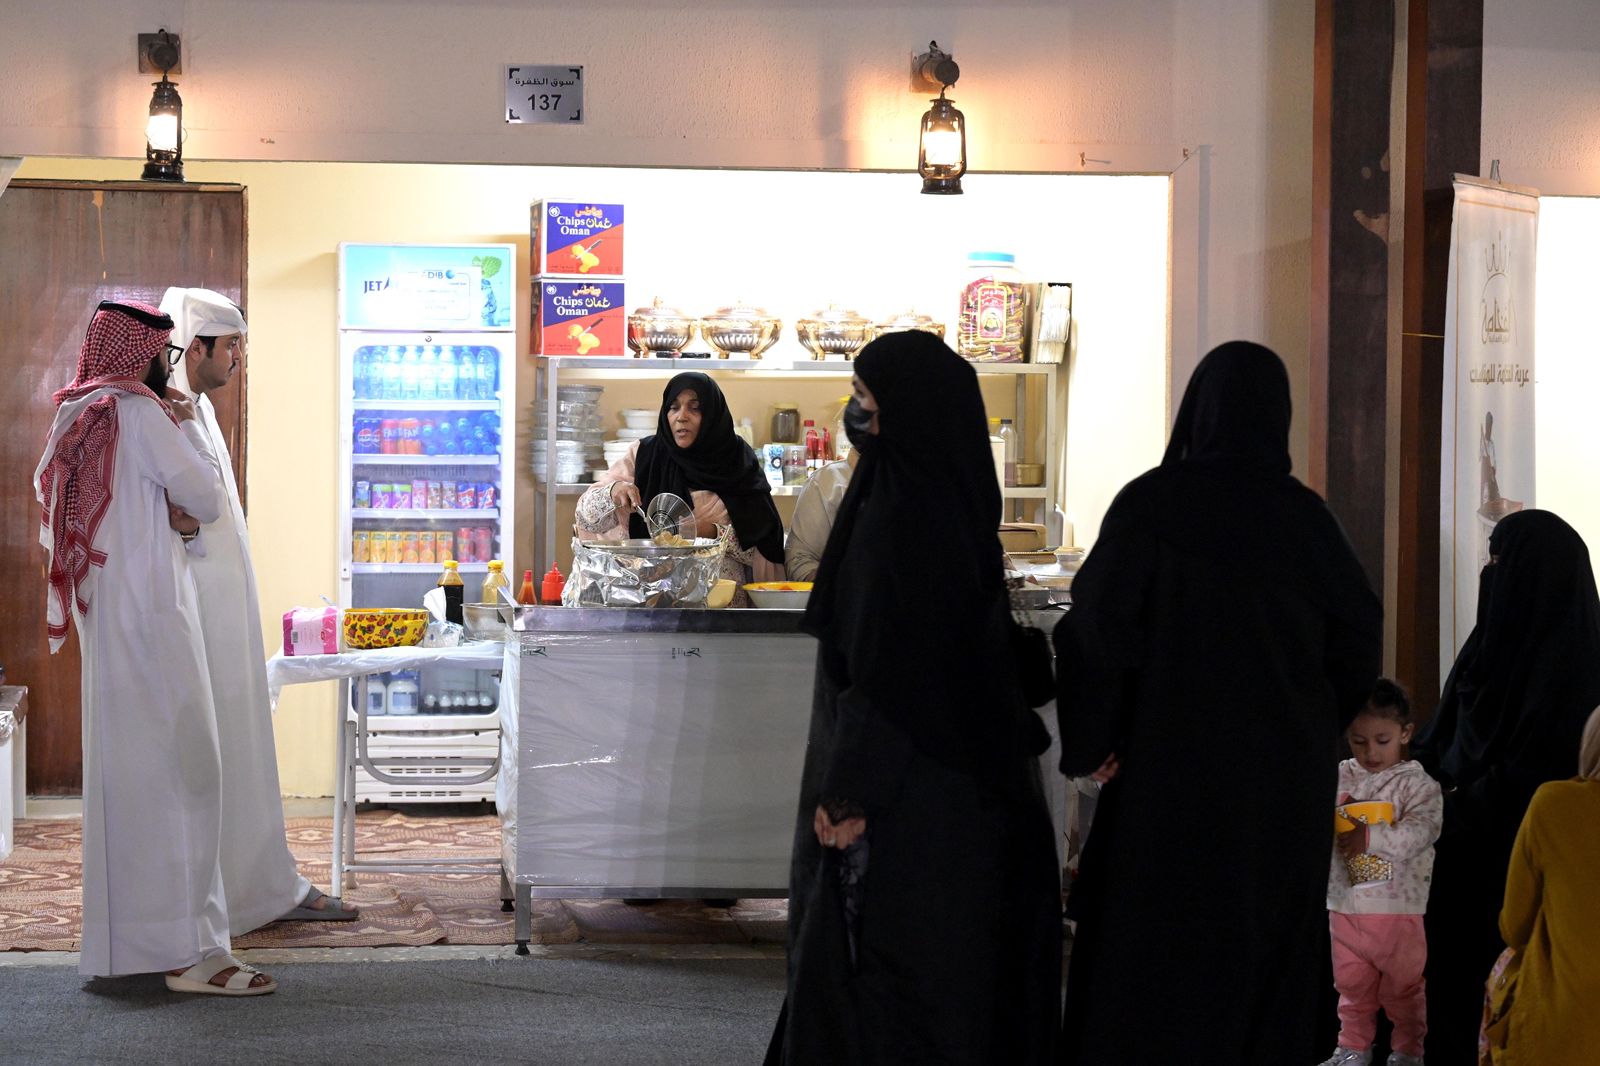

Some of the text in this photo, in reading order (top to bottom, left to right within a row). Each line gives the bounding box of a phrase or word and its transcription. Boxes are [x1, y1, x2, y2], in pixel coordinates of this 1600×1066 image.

[515, 77, 574, 87] سوق الظفرة
[528, 94, 562, 110] 137
[557, 216, 585, 227] Chips
[586, 218, 612, 229] عمان
[560, 225, 590, 235] Oman
[553, 295, 583, 308] Chips
[585, 297, 611, 308] عمان
[556, 306, 589, 316] Oman
